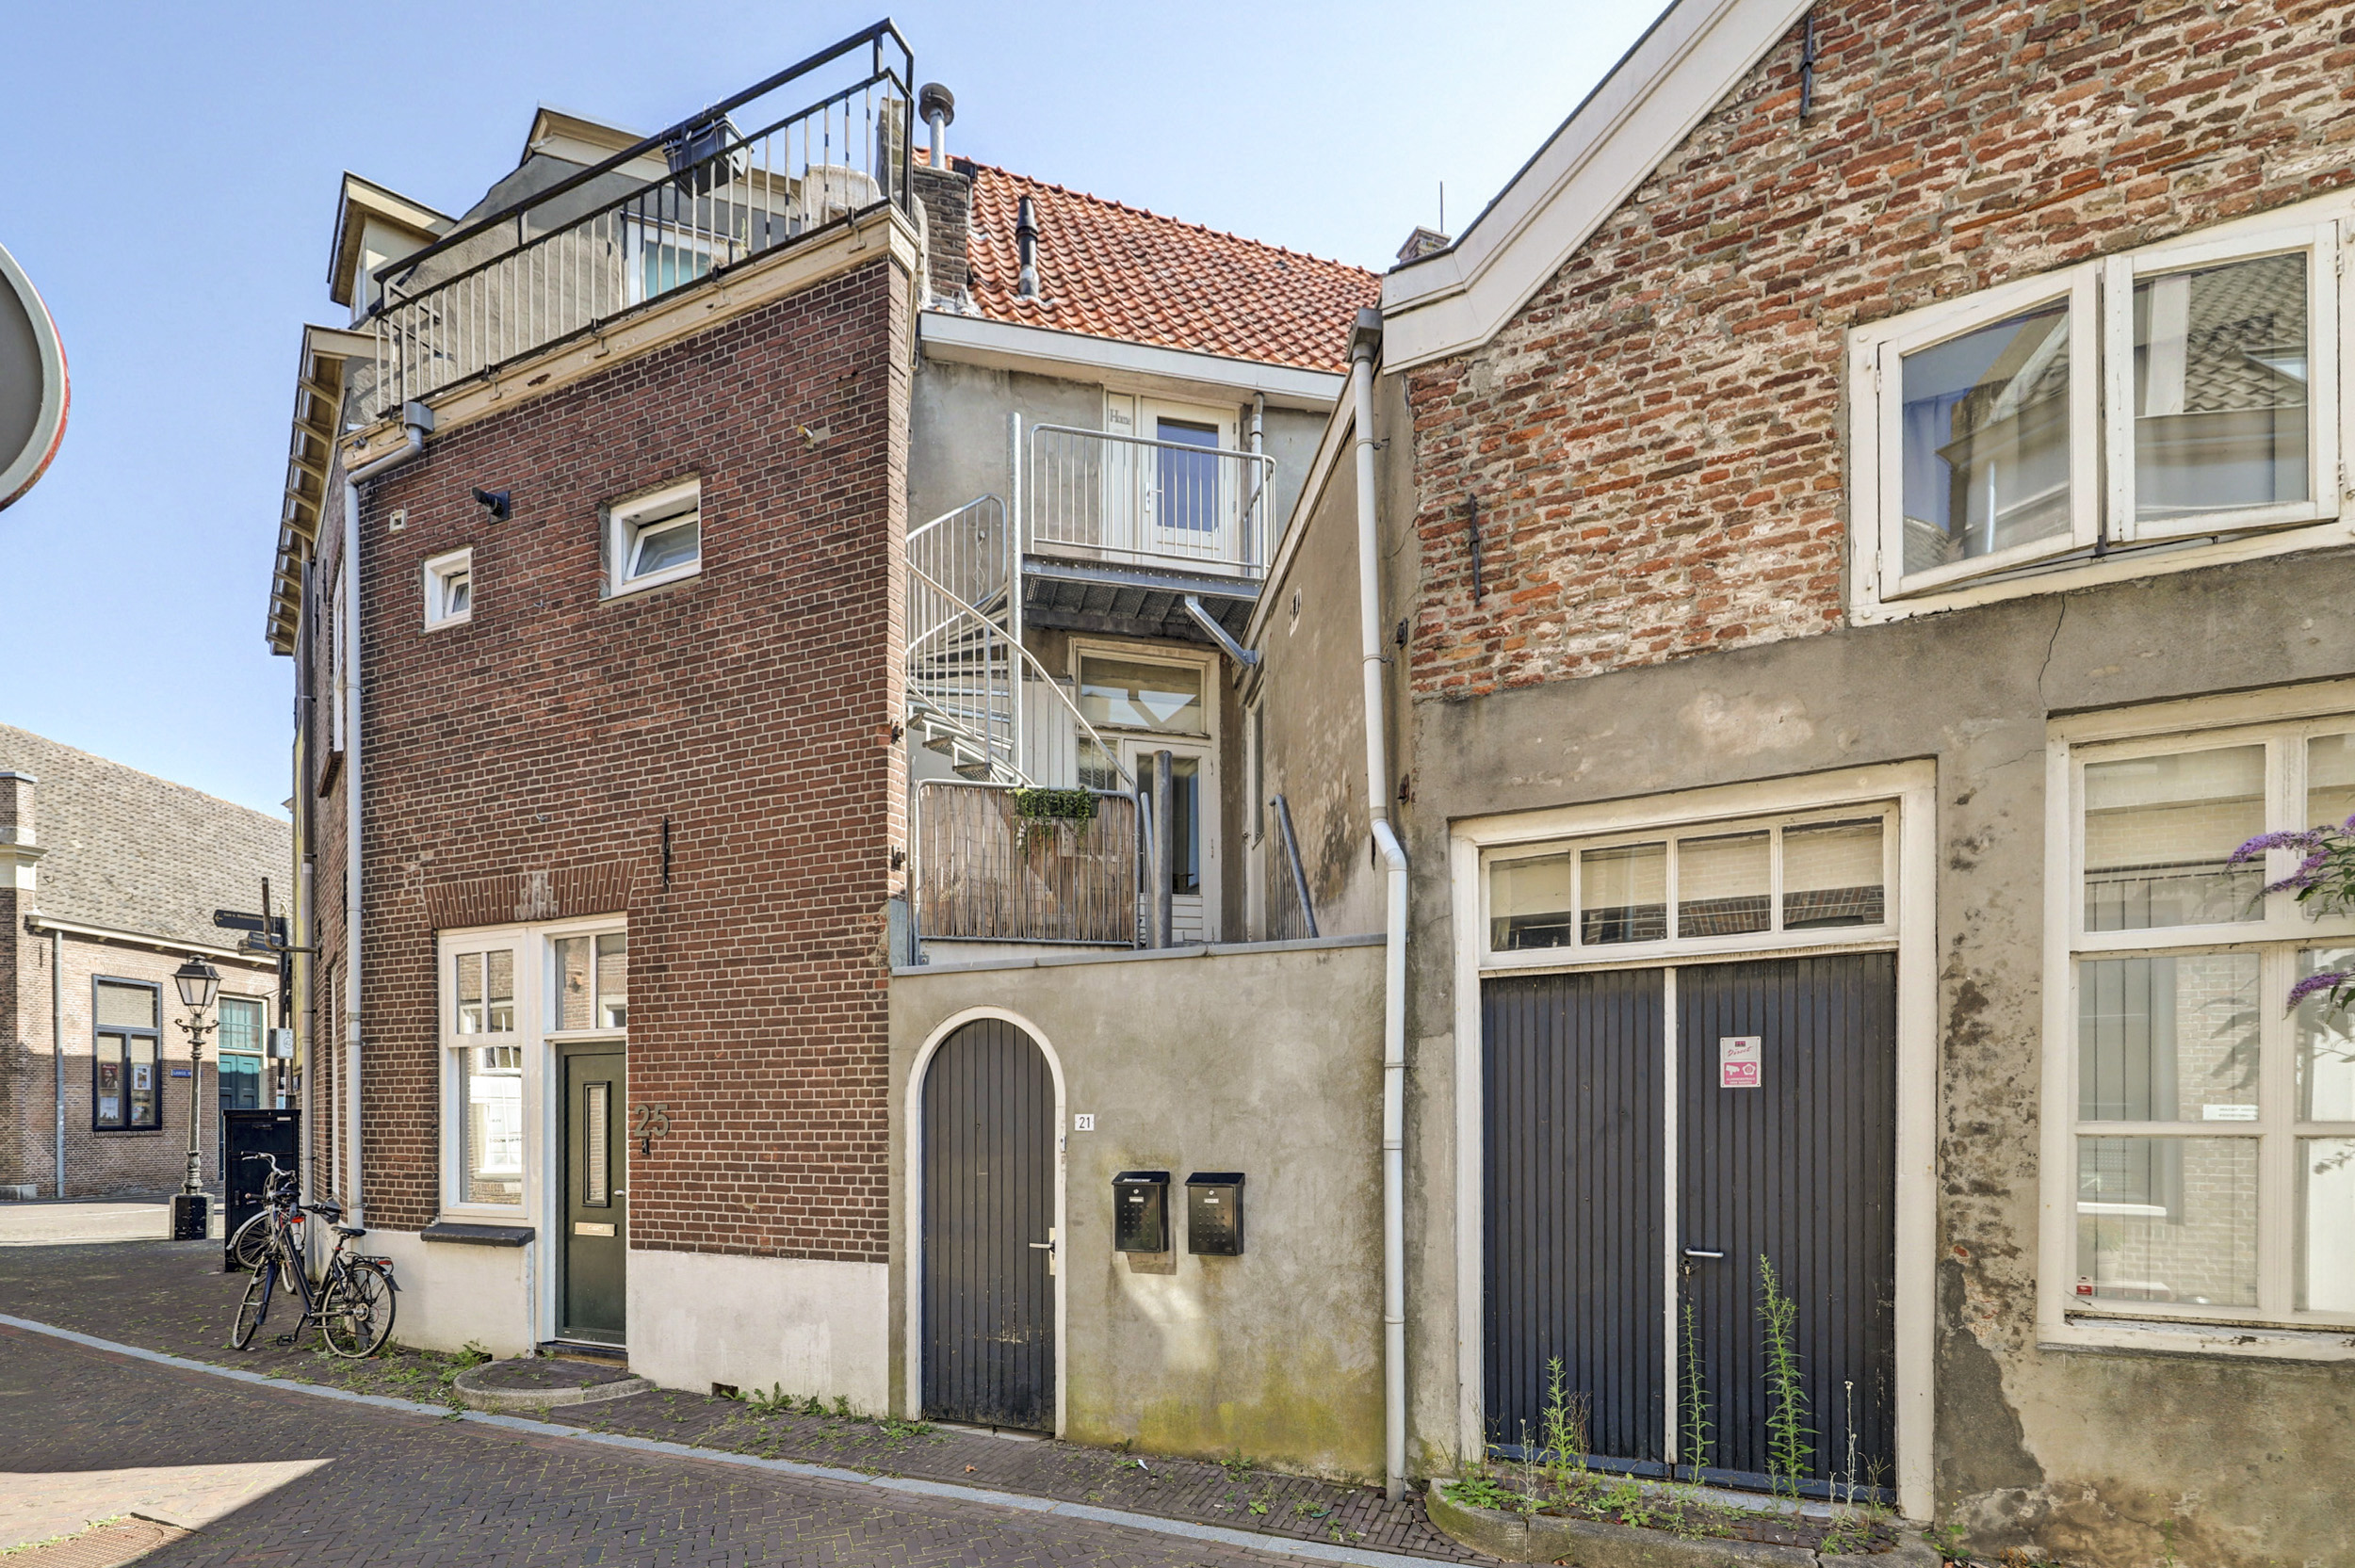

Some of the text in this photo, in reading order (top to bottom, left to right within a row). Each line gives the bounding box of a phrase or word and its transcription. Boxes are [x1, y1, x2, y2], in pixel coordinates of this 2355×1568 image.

[1110, 409, 1131, 426] Home
[633, 1104, 670, 1137] 25
[1079, 1116, 1090, 1128] 21
